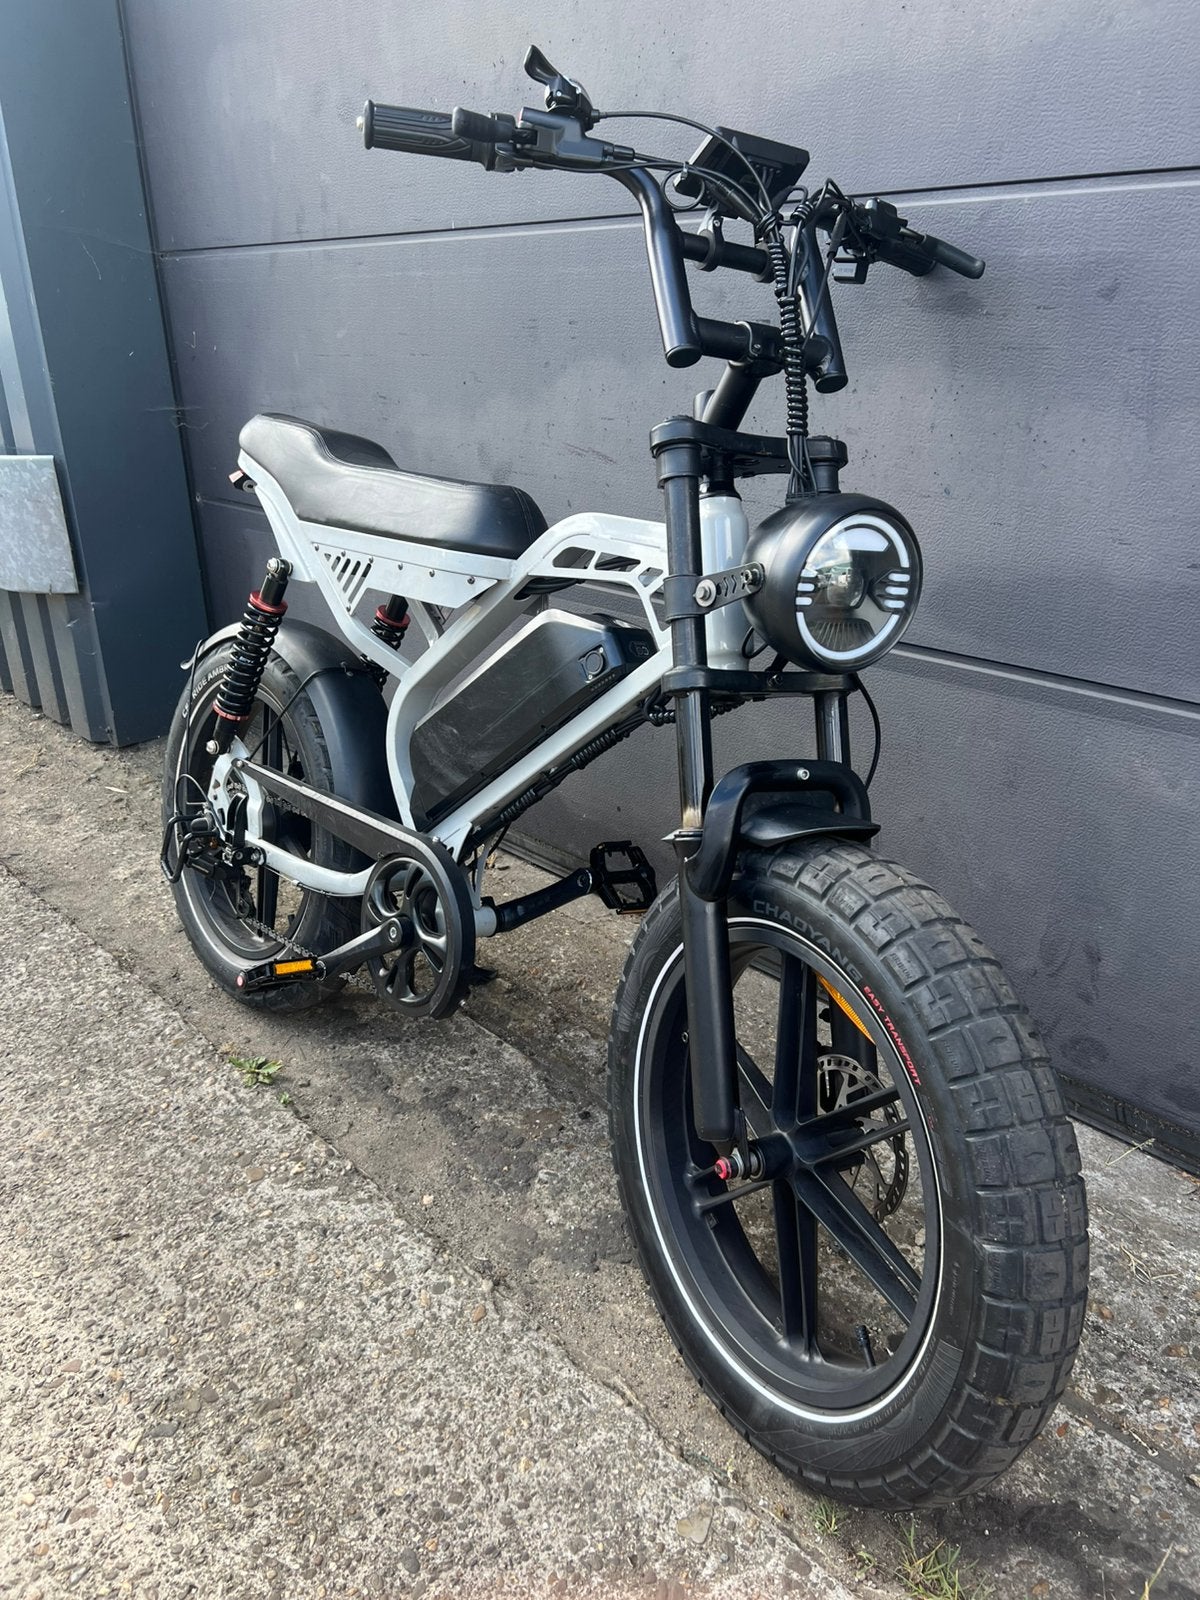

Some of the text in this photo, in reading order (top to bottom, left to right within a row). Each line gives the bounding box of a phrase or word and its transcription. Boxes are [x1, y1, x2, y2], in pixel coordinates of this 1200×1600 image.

[191, 677, 208, 699] RIDE
[753, 900, 863, 983] CHAOYANG
[863, 985, 922, 1087] EASY TRANSPORT
